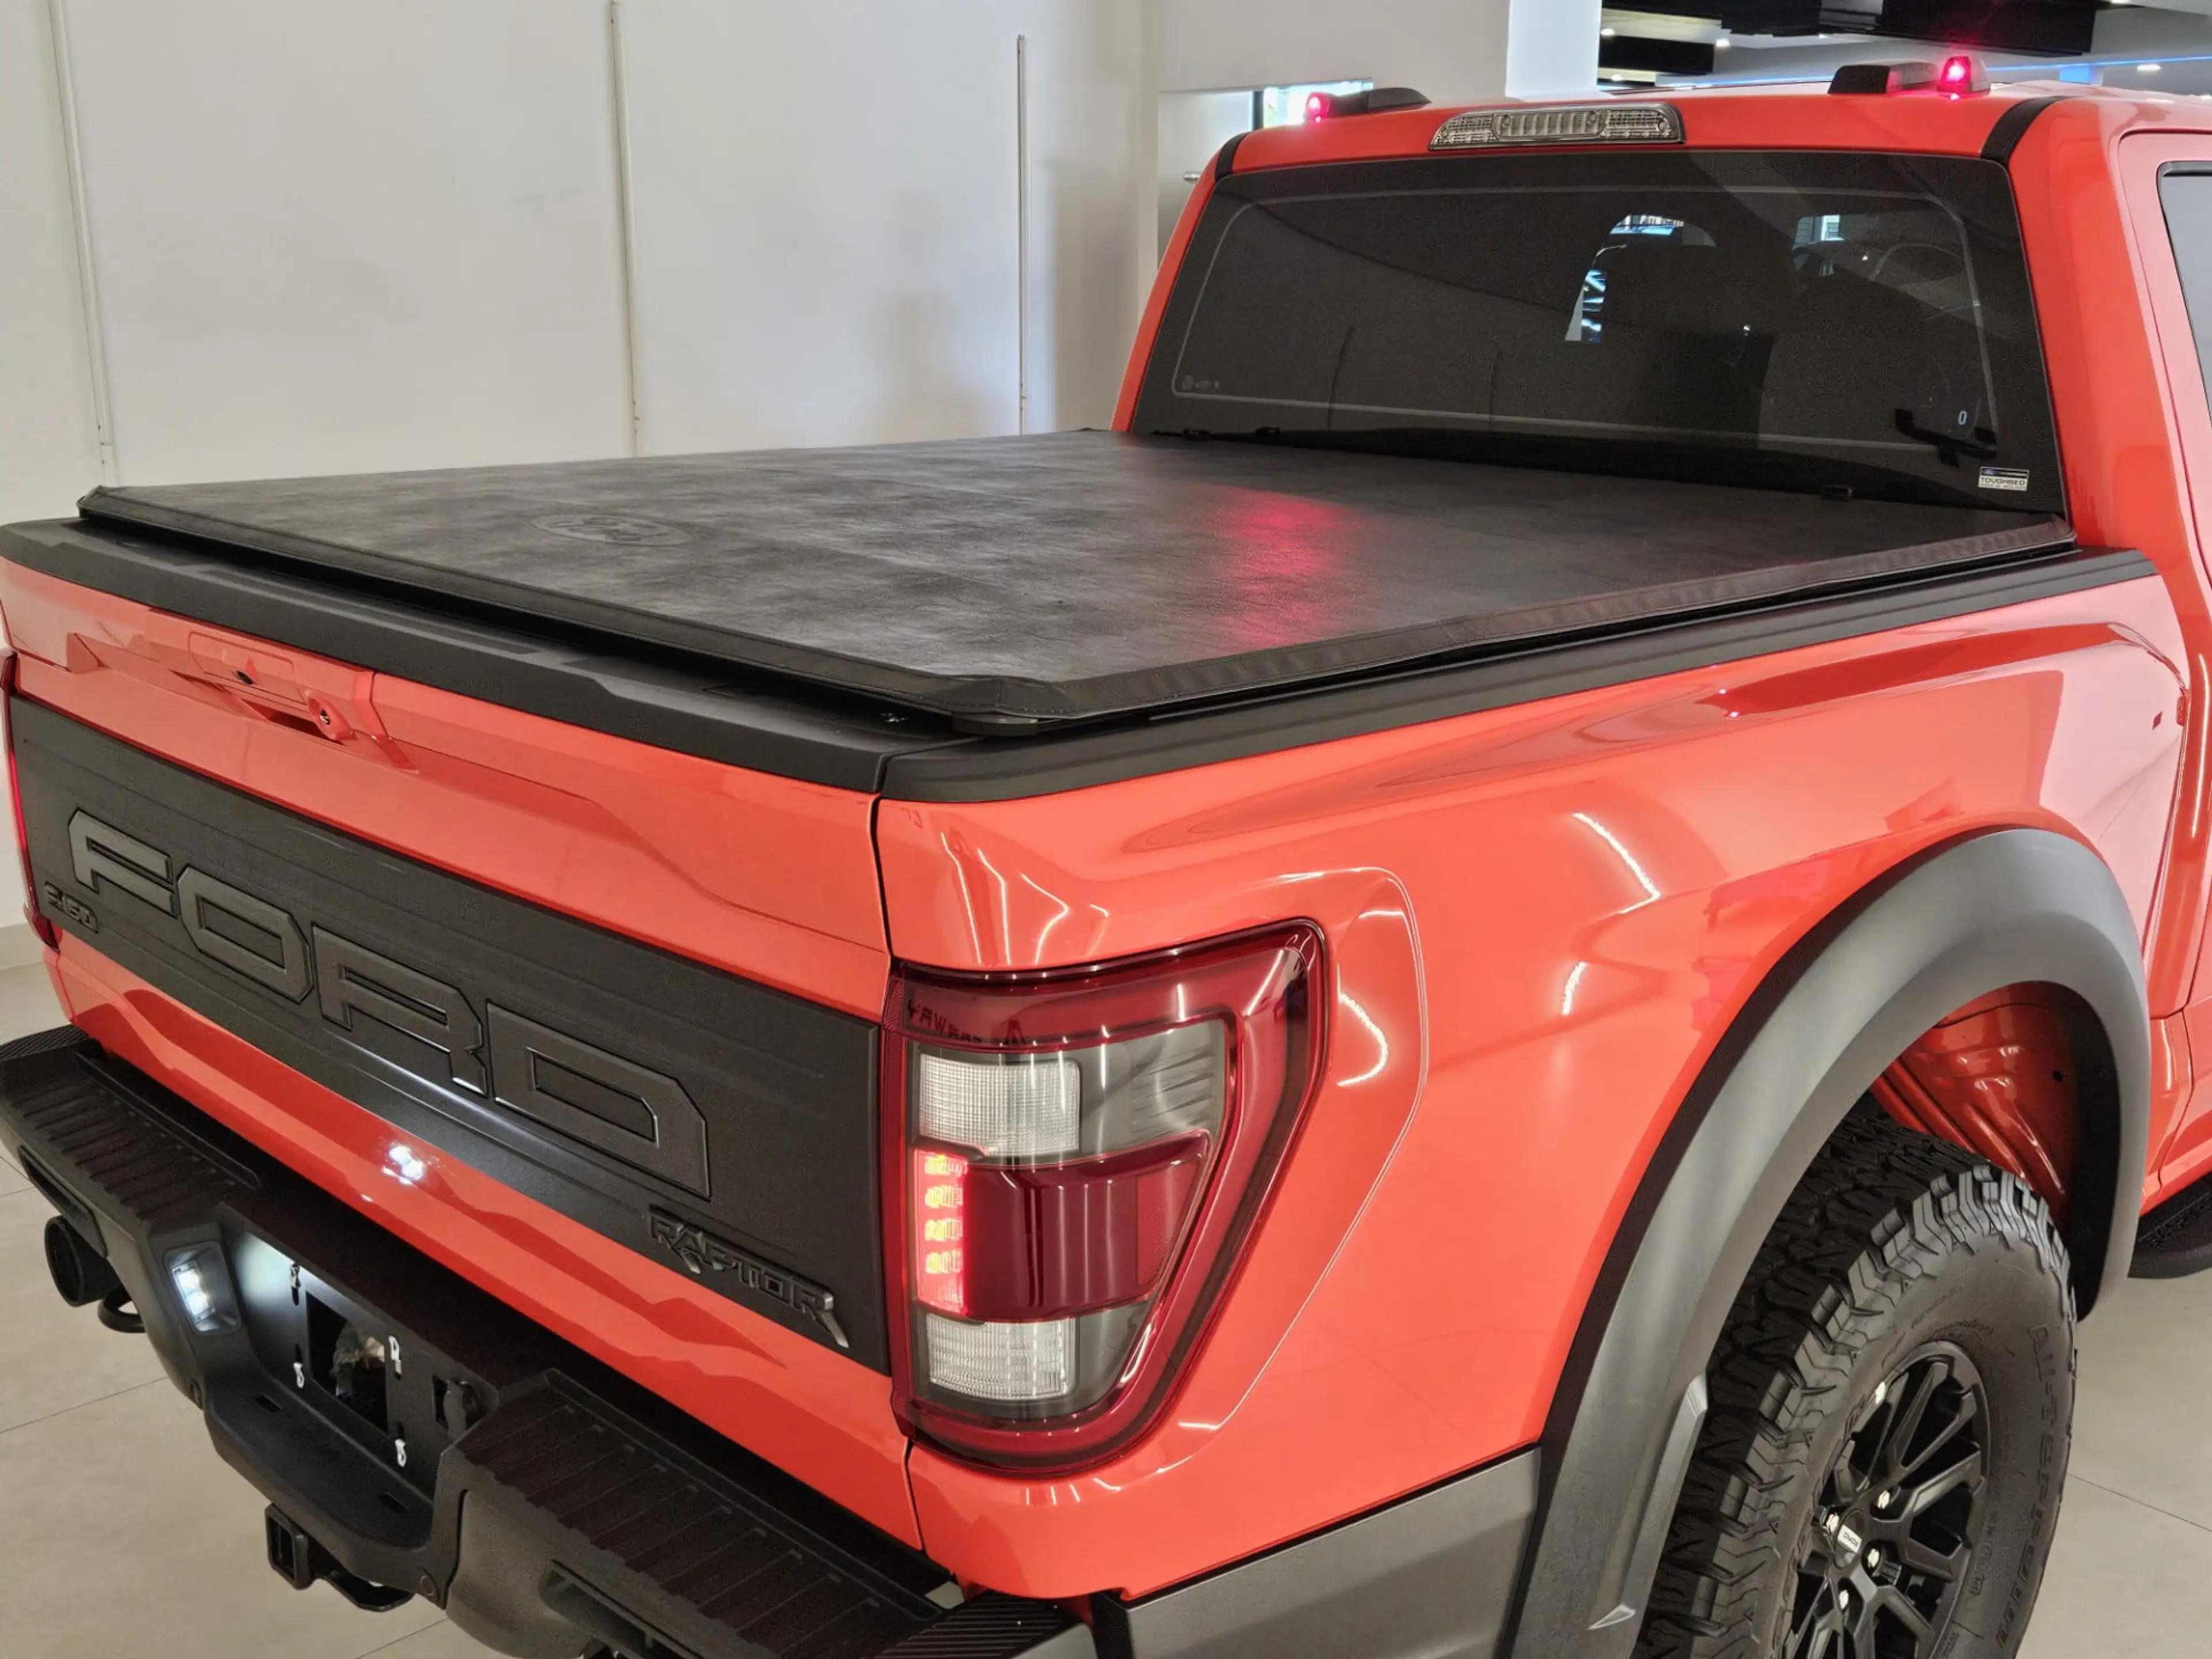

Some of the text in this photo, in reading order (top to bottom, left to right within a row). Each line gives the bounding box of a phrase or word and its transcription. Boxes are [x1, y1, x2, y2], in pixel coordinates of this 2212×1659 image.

[1980, 476, 2026, 486] TOUGHBED
[67, 806, 712, 1202] FORD
[647, 1203, 850, 1349] RAPTOR
